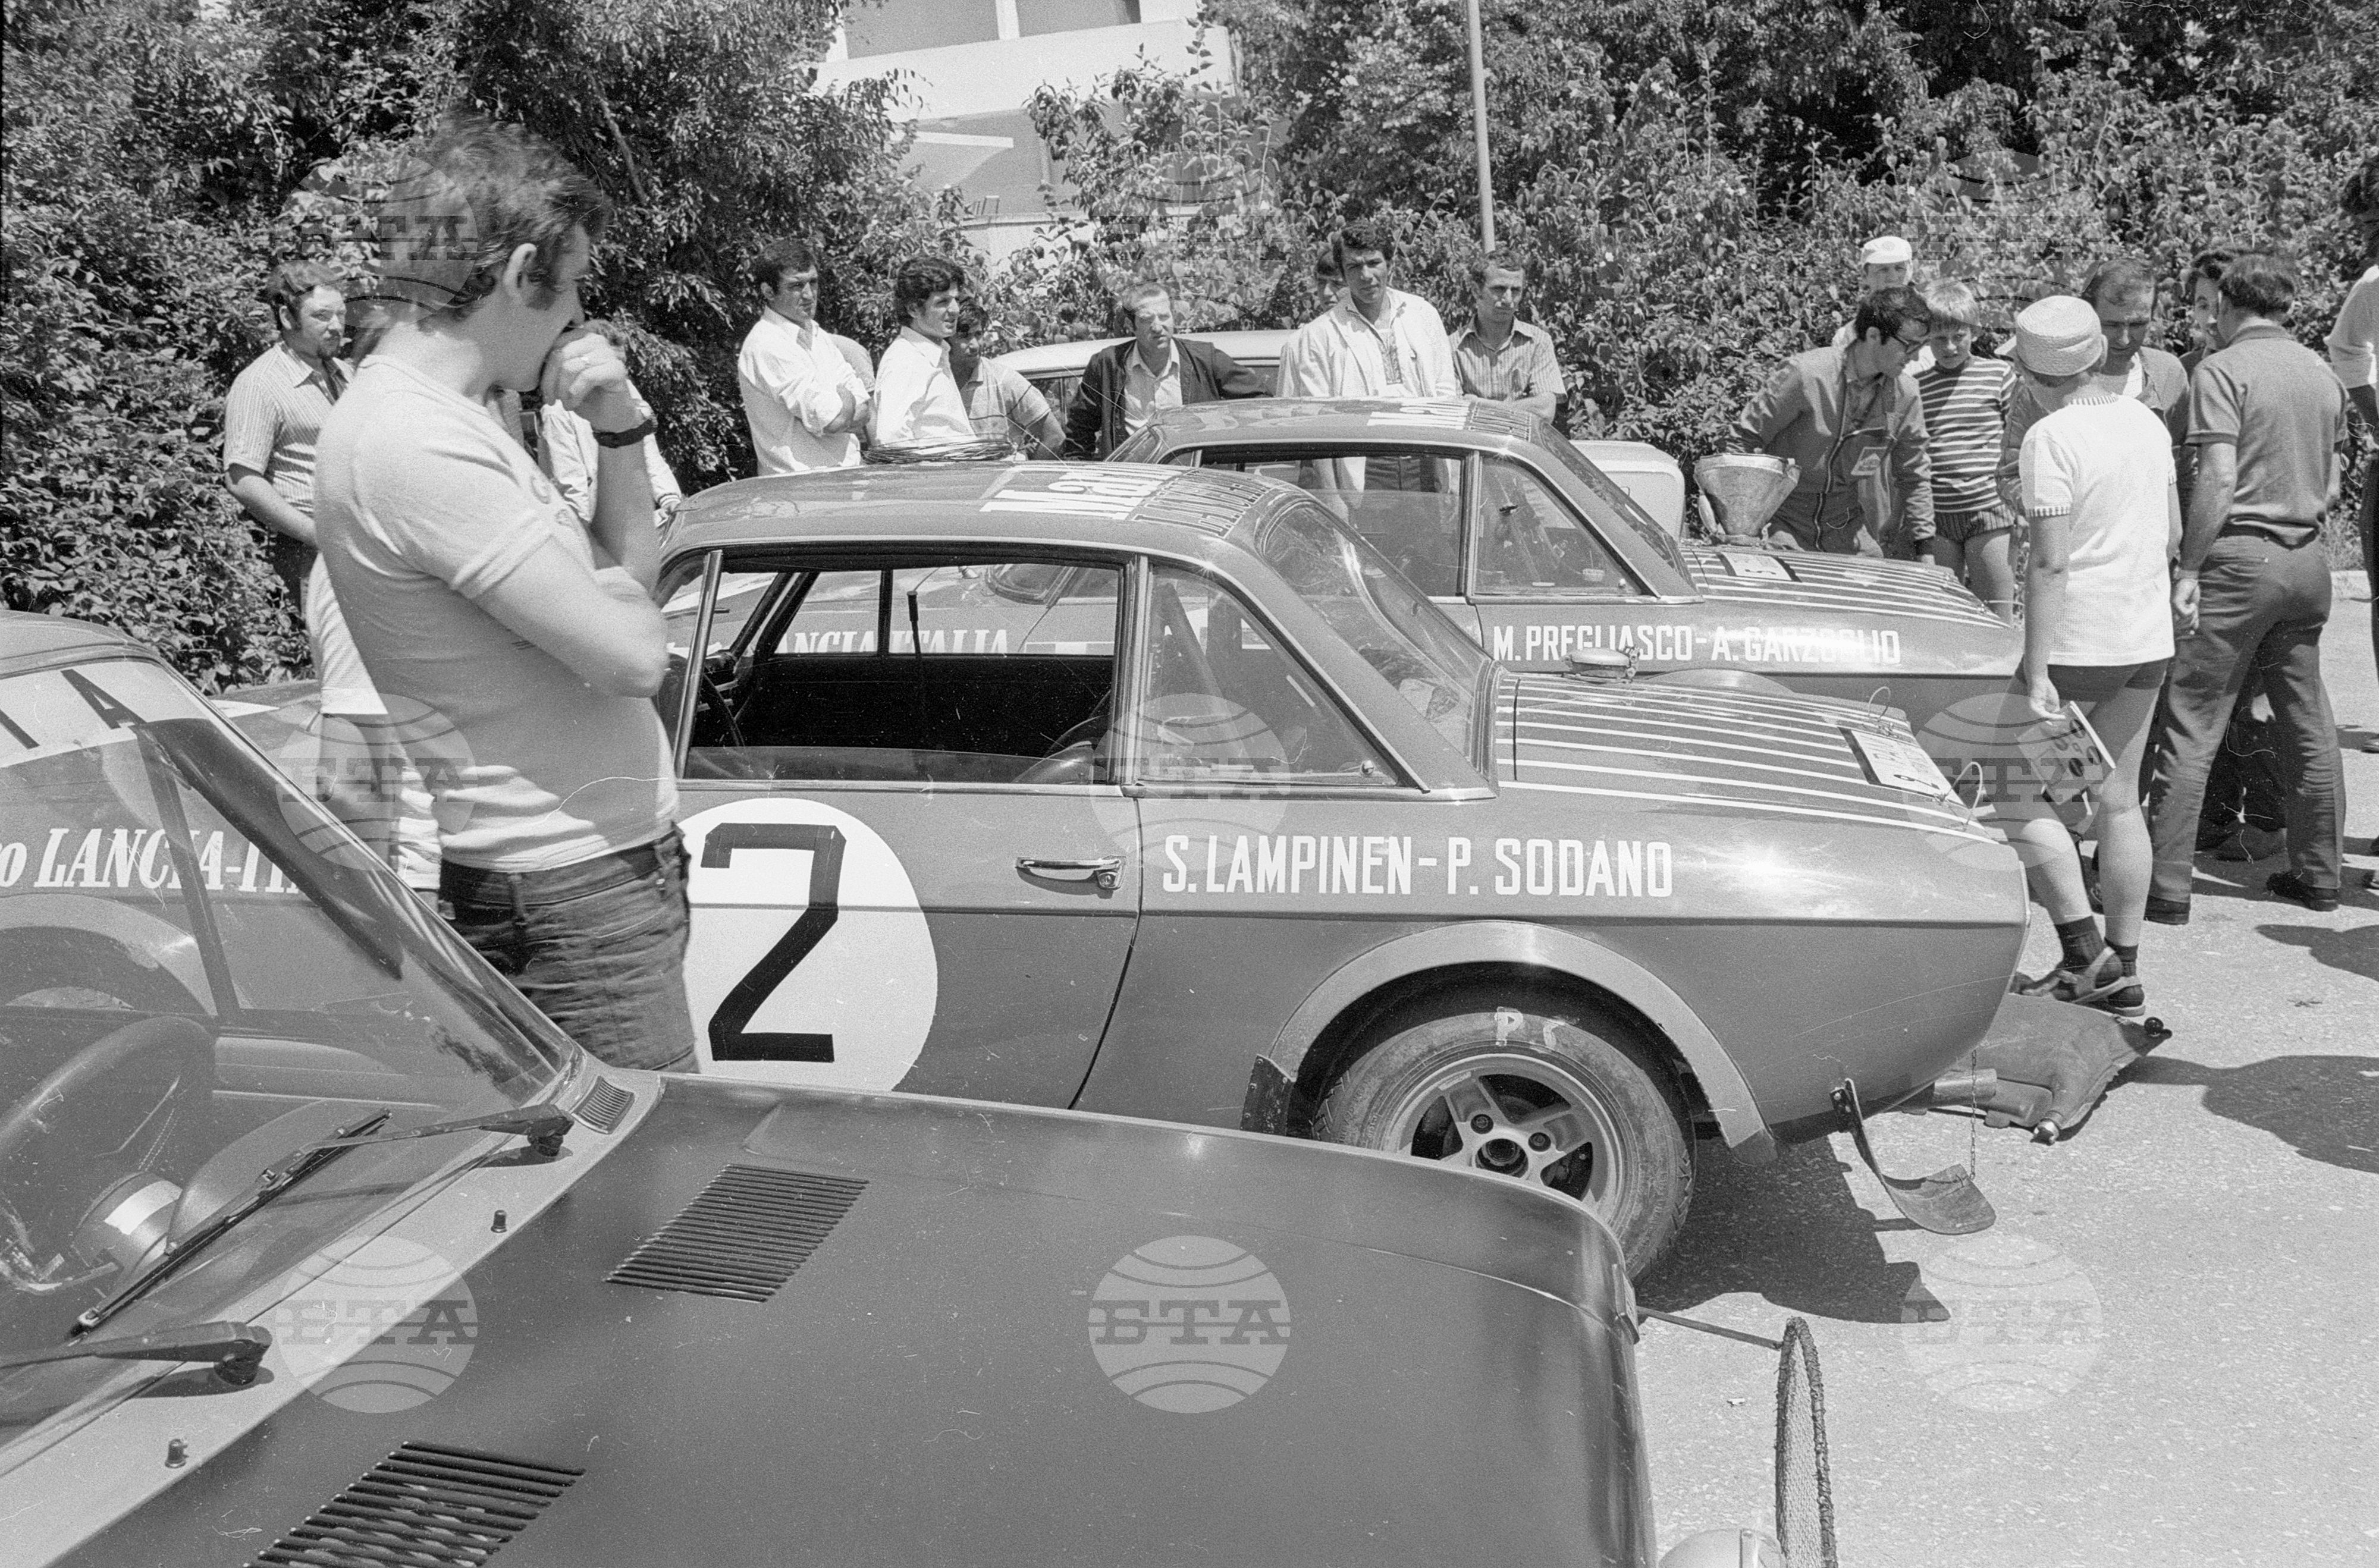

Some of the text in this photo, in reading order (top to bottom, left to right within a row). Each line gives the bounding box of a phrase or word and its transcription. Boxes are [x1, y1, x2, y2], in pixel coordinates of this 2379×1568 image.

[1493, 625, 1521, 661] M.
[1495, 838, 1674, 898] SODANO
[700, 822, 847, 1064] 2
